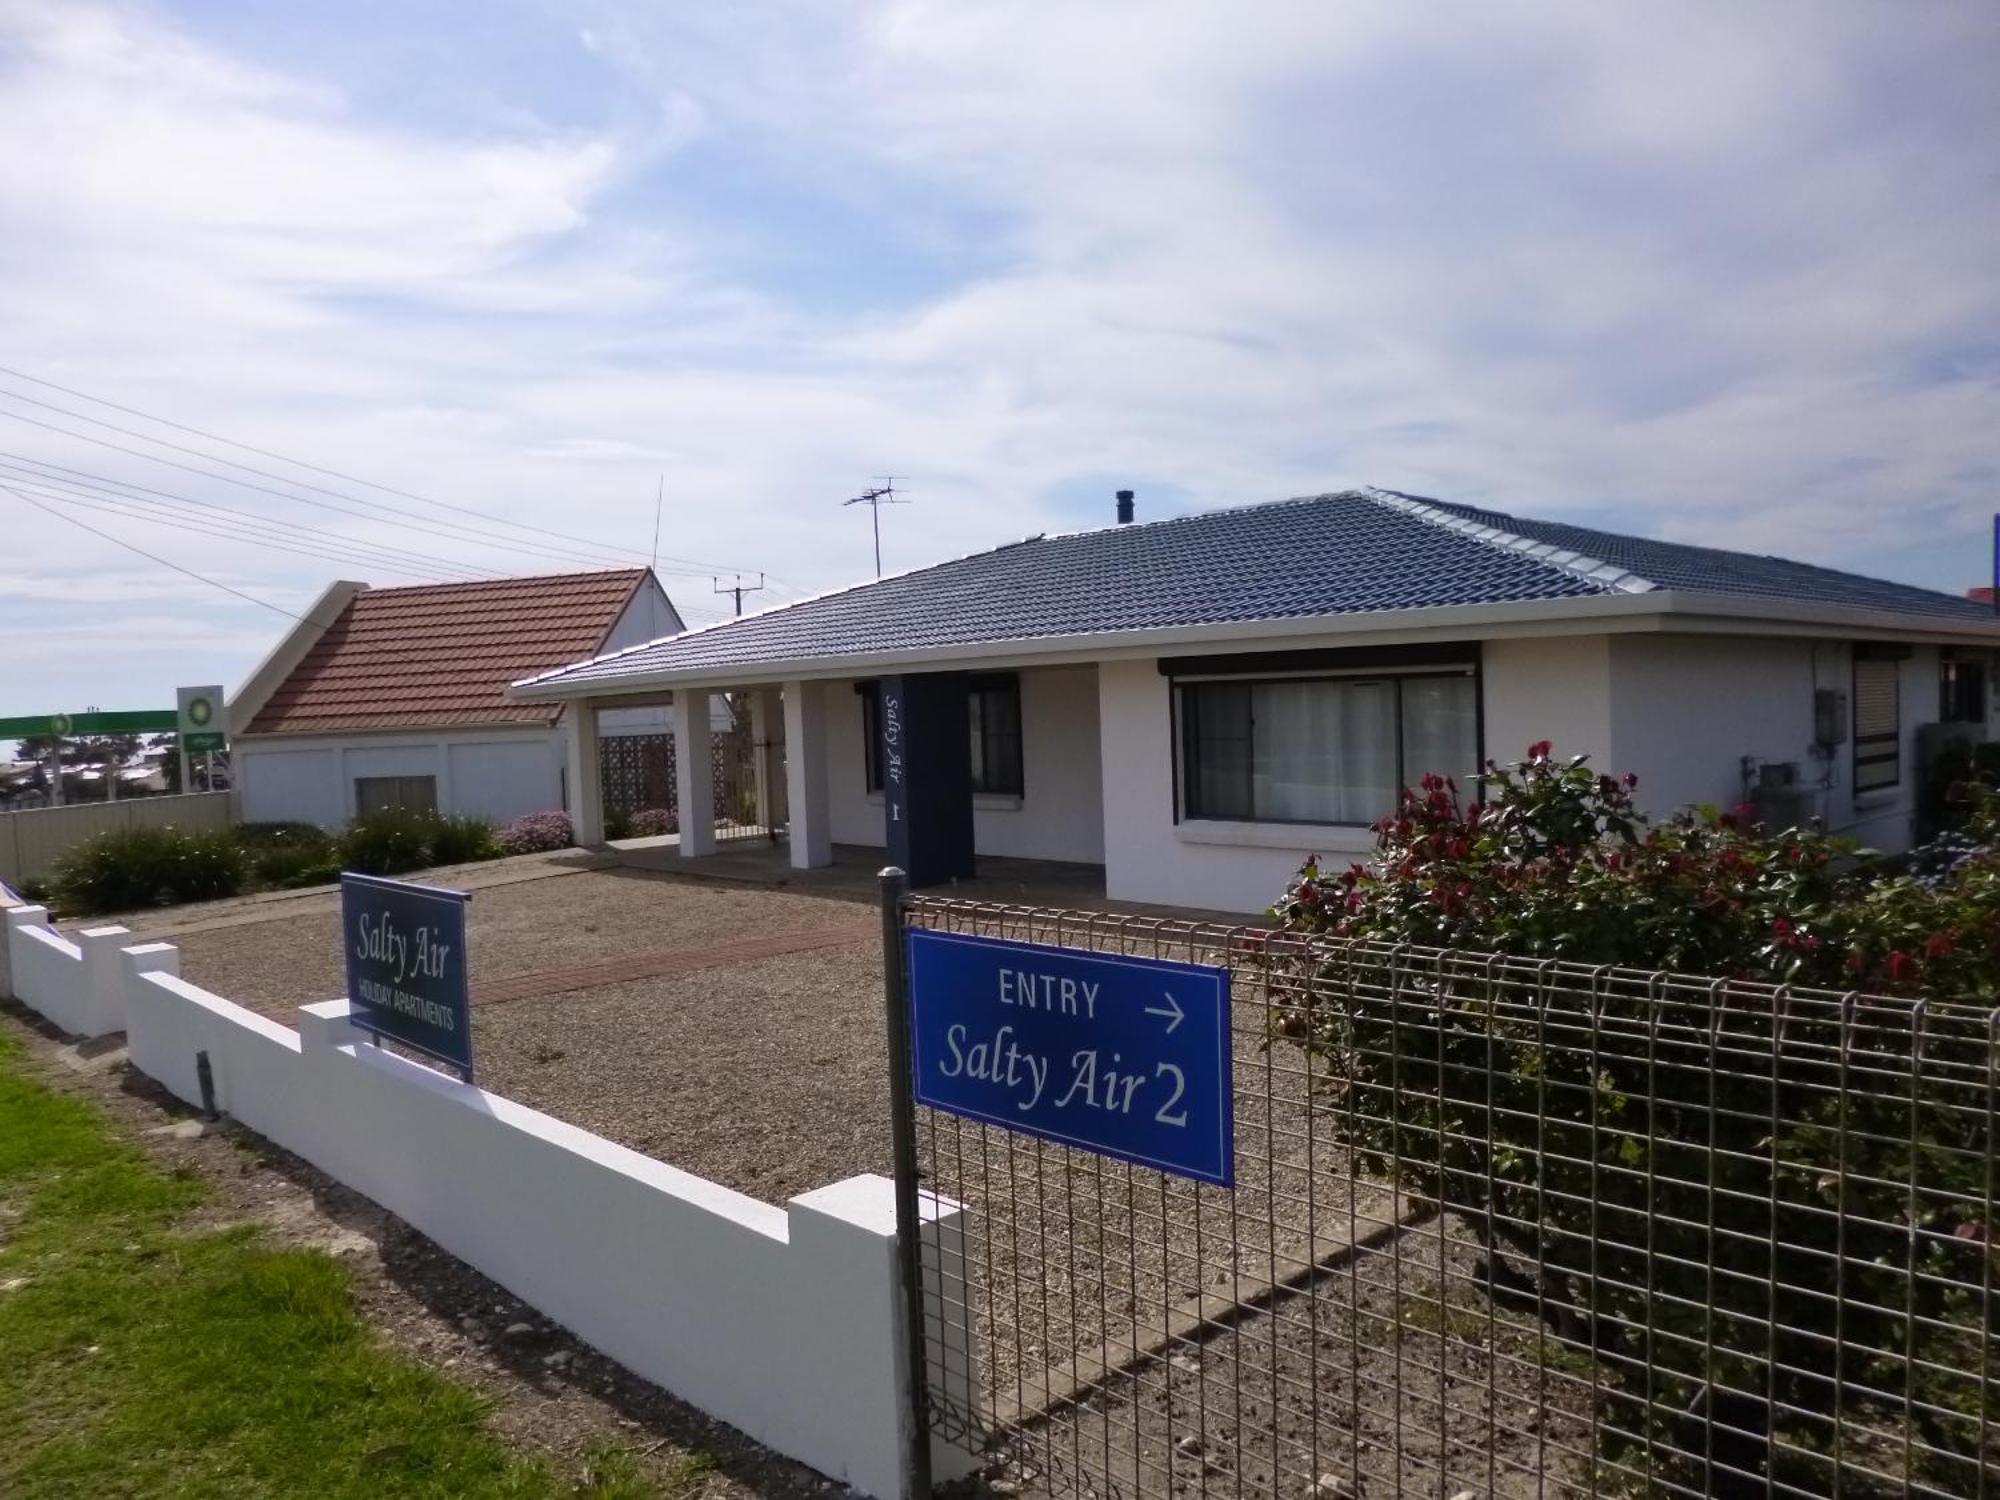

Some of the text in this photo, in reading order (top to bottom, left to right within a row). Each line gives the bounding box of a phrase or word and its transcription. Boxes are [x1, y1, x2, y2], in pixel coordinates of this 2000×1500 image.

[884, 695, 900, 745] Salty
[888, 748, 902, 784] Air
[357, 911, 451, 984] Salty Air
[359, 978, 454, 1031] HOLIDAY APARTMENTS
[999, 968, 1099, 1019] ENTRY
[939, 1024, 1188, 1128] Salty Air 2
